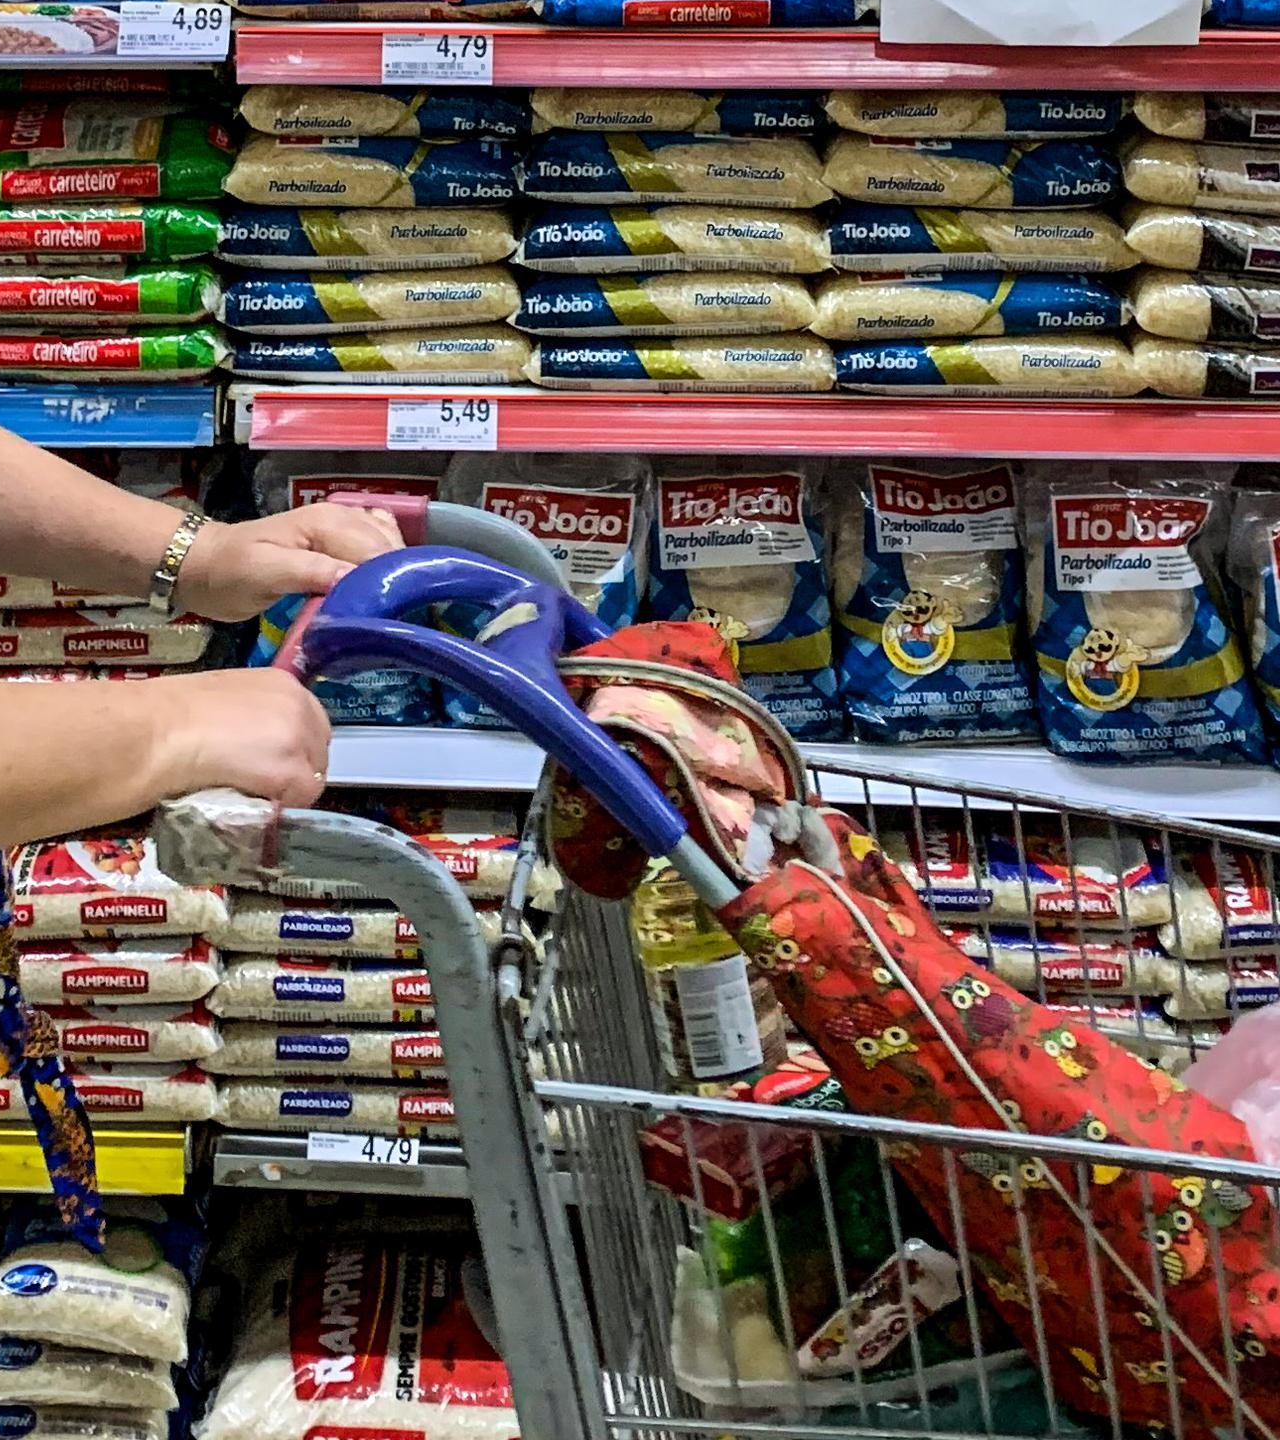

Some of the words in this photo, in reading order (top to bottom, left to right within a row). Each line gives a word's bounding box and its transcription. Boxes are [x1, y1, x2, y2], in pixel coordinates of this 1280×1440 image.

[171, 7, 223, 34] 4,89
[669, 3, 732, 24] carreteiro
[436, 34, 487, 63] 4,79
[574, 110, 653, 127] Parboilizado
[49, 172, 116, 193] carreteiro
[268, 179, 347, 196] Parboilizado
[34, 226, 100, 246] carreteiro
[1014, 224, 1094, 241] Parboilizado
[856, 314, 935, 331] Parboilizado
[440, 398, 491, 427] 5,49
[881, 518, 965, 537] Parboilizado
[1063, 511, 1110, 541] Tio
[664, 530, 754, 550] Parboilizado
[1060, 553, 1152, 572] Parboilizado
[68, 638, 145, 652] RAMPINELLI
[84, 902, 165, 918] RAMPINELLI
[66, 975, 146, 989] RAMPINELLI
[66, 1033, 146, 1048] RAMPINELLI
[361, 1137, 412, 1164] 4,79
